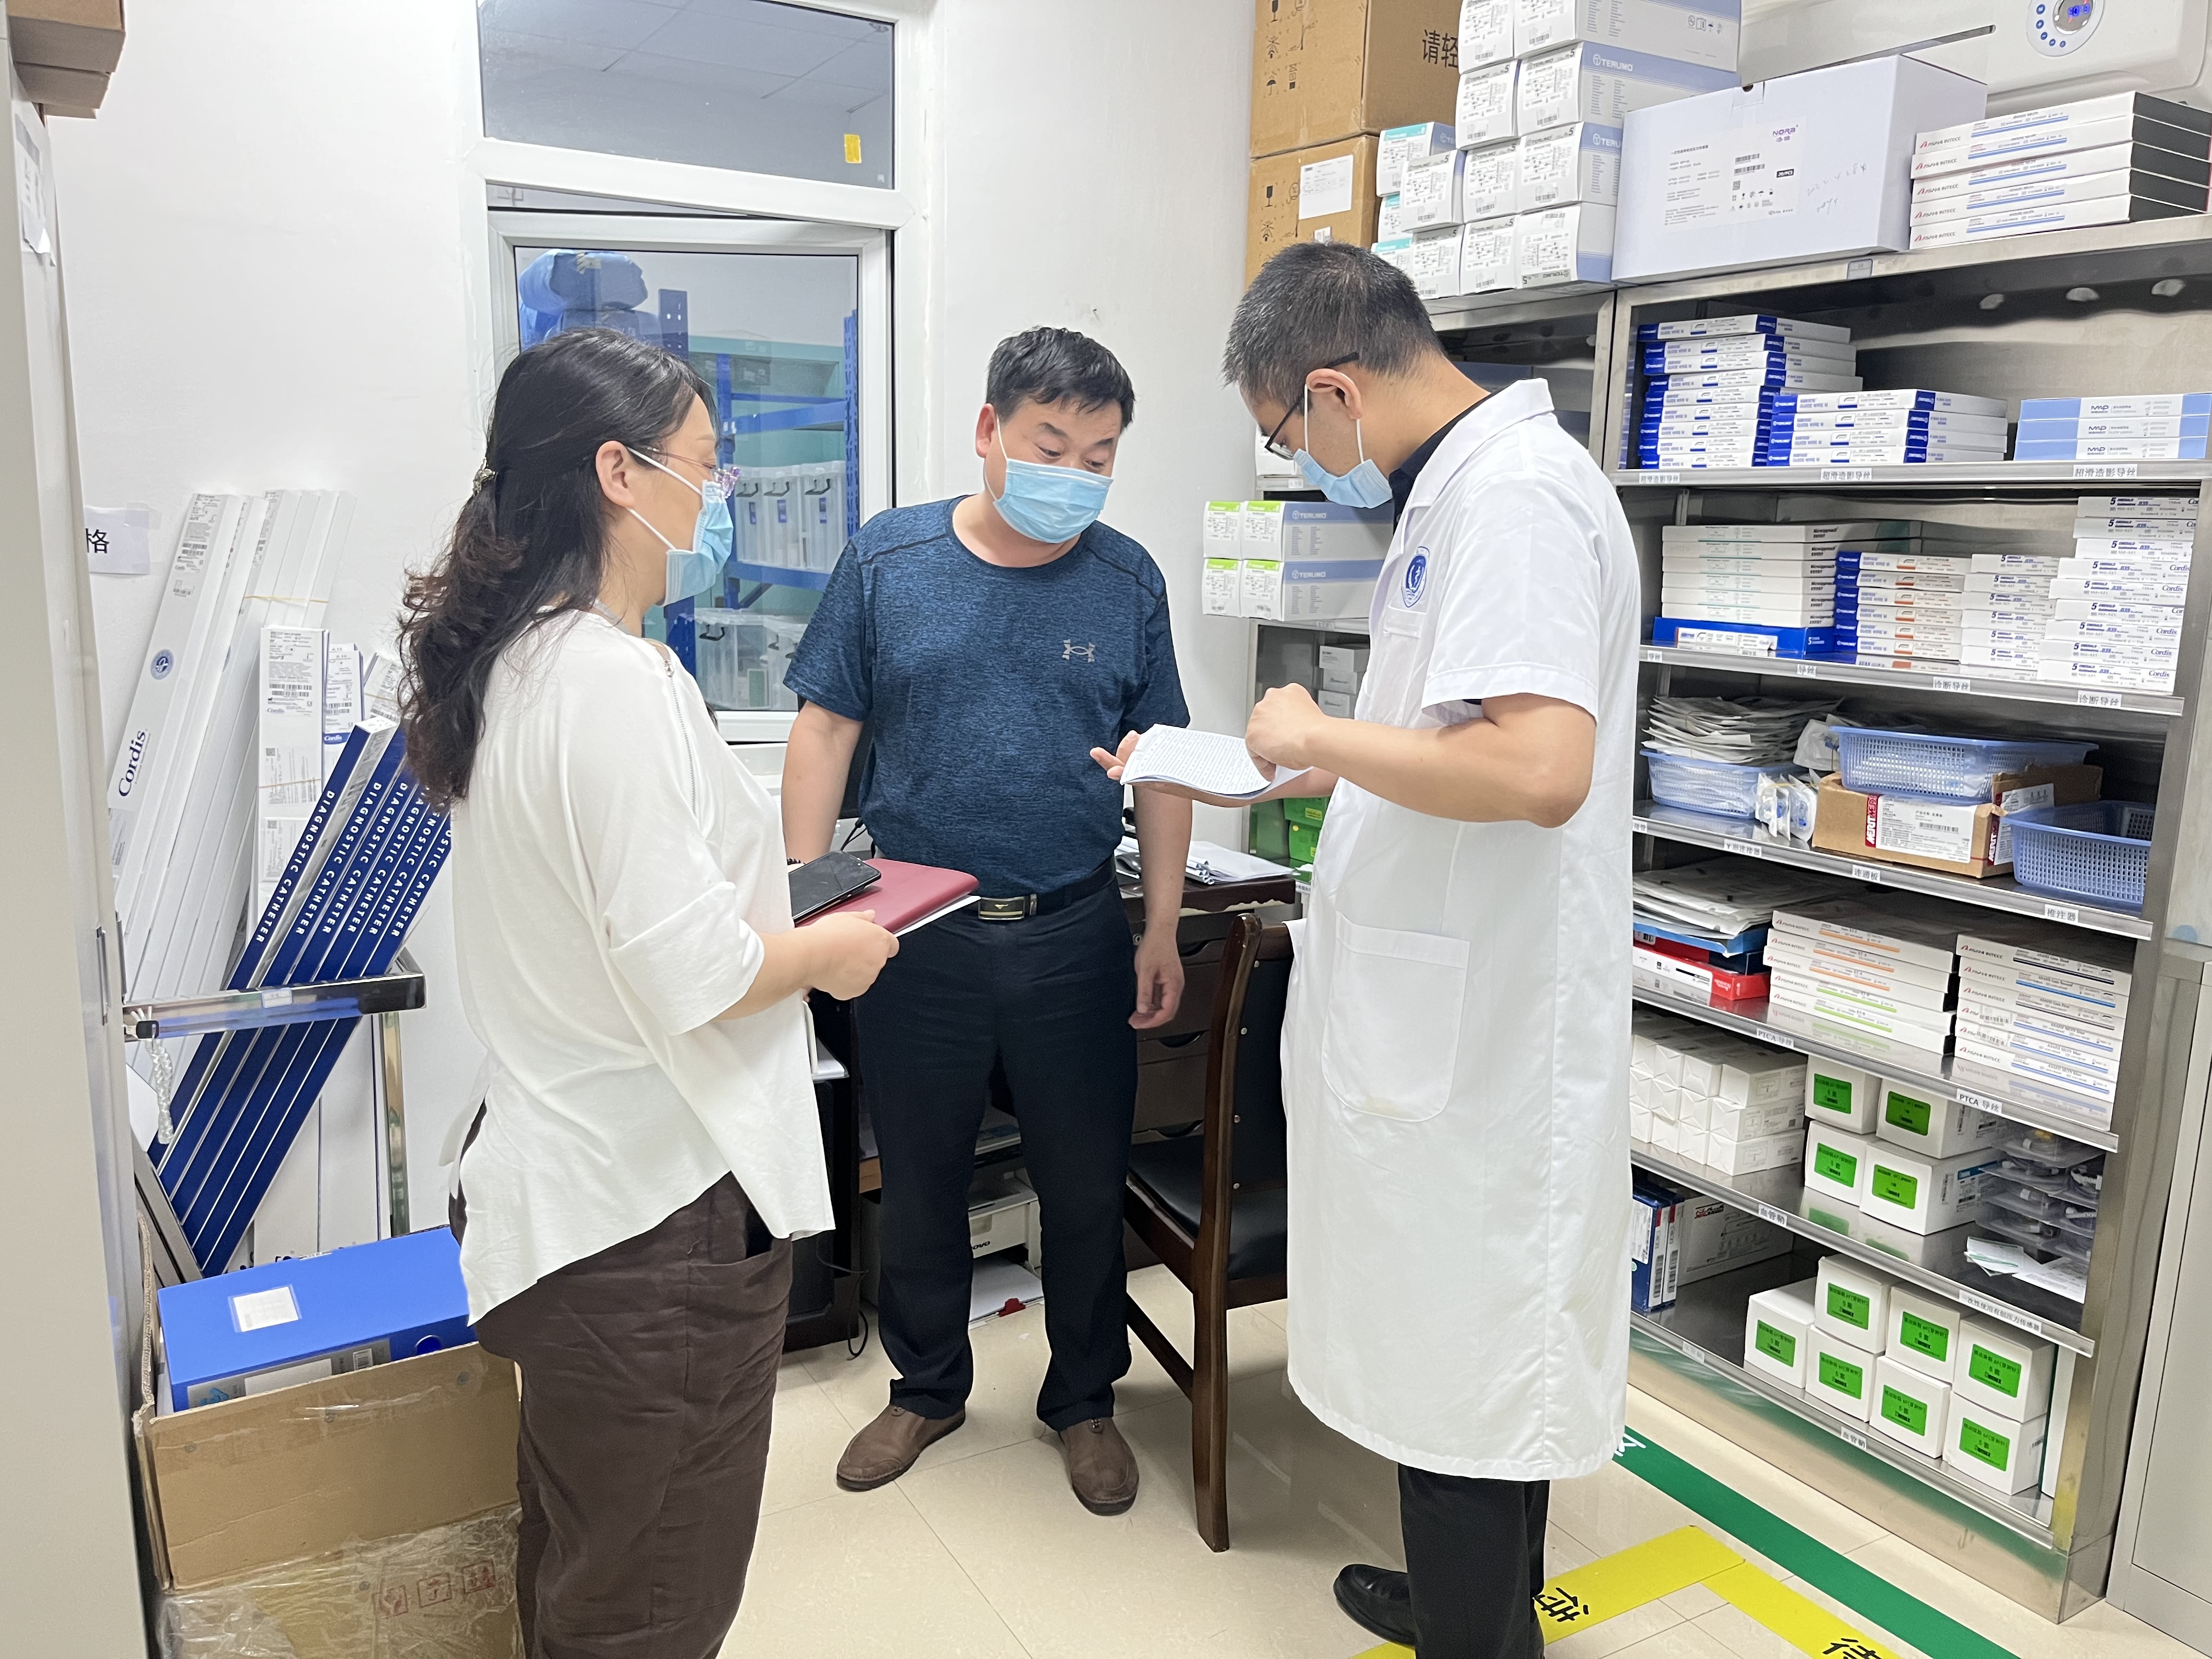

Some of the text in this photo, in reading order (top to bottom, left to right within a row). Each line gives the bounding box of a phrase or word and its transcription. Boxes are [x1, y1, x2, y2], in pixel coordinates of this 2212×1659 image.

[1601, 58, 1633, 71] TERUMO
[2074, 467, 2136, 477] 超滑造影导丝
[2111, 497, 2117, 505] 5
[1934, 680, 1969, 690] 诊断导丝
[2079, 695, 2119, 706] 诊断导丝
[119, 730, 146, 797] Cordis
[290, 790, 335, 873] DIAGNOSTIC
[1866, 815, 1876, 845] MERIT
[296, 782, 382, 935] DIAGNOSTIC CATHETER
[322, 782, 408, 934] DIAGNOSTIC CATHETER
[256, 878, 292, 943] CATHETER
[347, 869, 386, 933] CATHETER
[369, 871, 408, 935] CATHETER
[391, 873, 430, 938] CATHETER
[2047, 908, 2076, 922] 推注器
[1758, 1031, 1776, 1042] PTCA
[1960, 1094, 1979, 1106] PTCA
[972, 1240, 990, 1250] ovo
